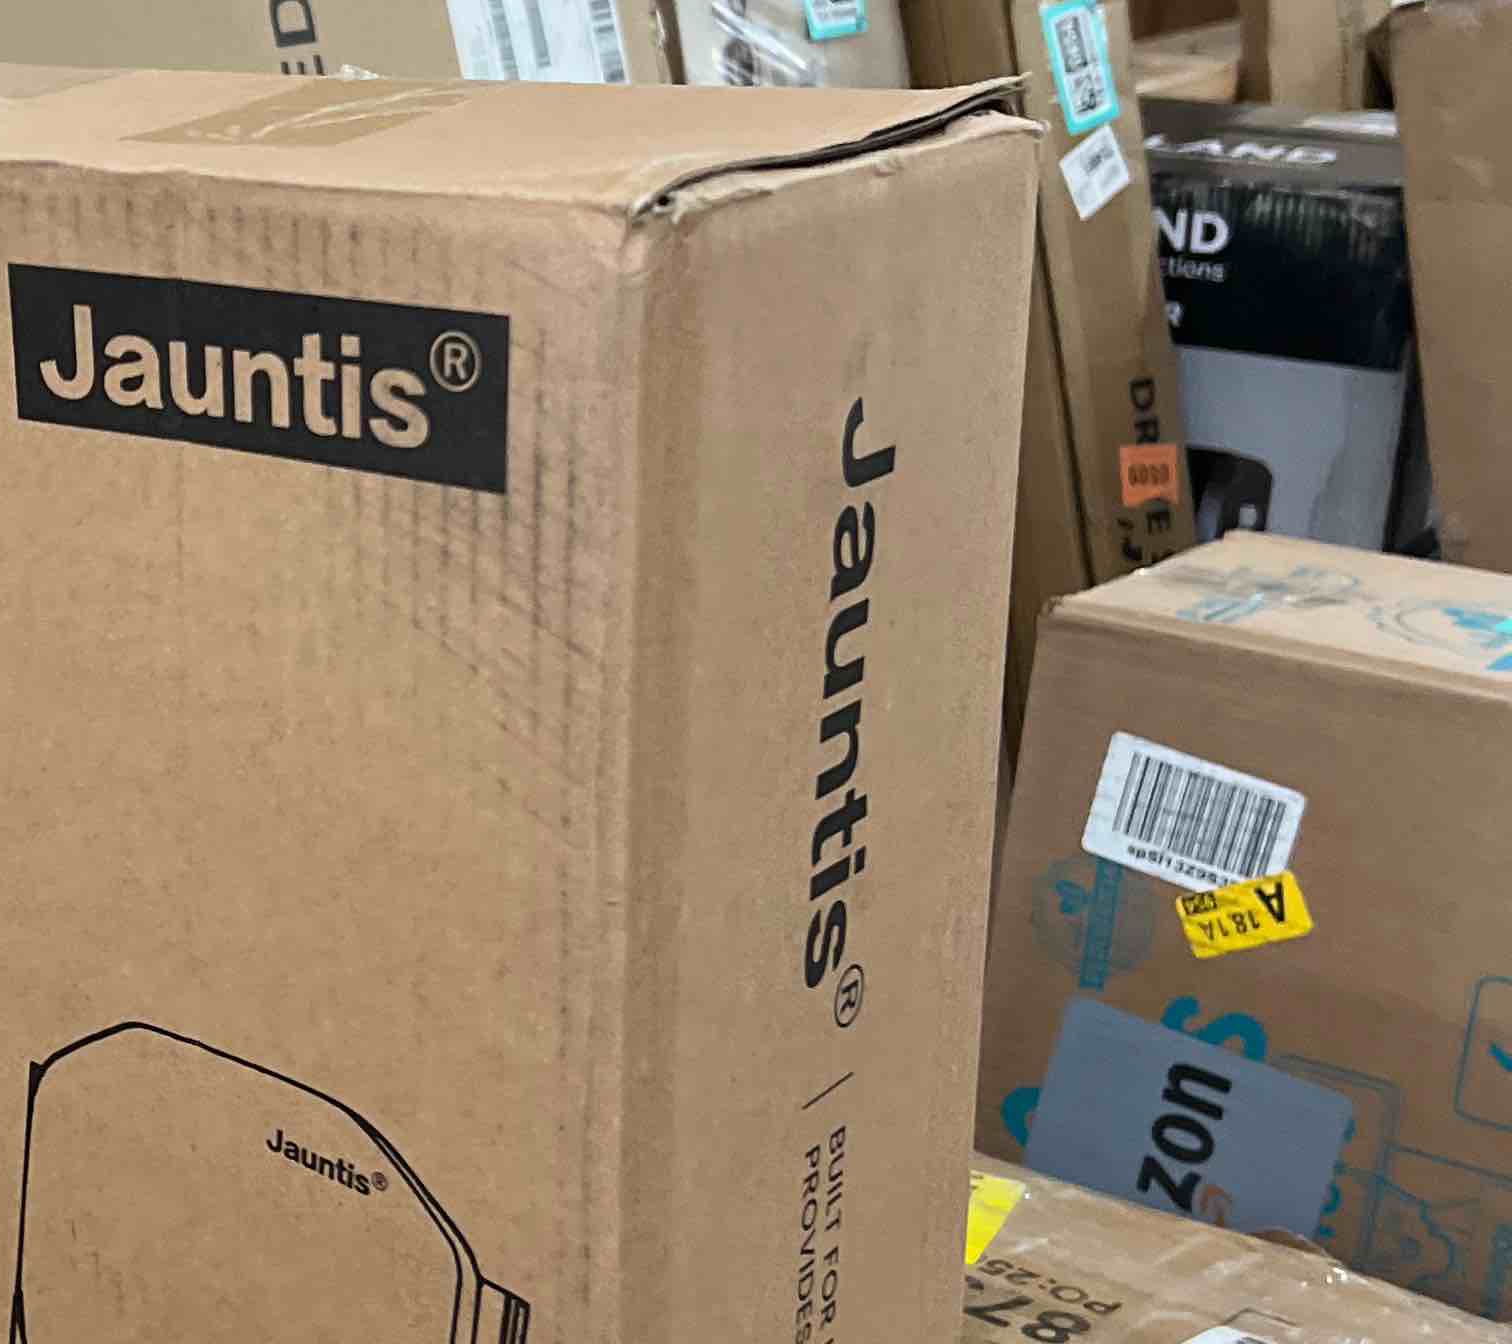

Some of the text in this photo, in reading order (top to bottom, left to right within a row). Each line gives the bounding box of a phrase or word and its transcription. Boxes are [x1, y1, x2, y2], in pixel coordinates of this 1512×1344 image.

[1256, 880, 1287, 925] A
[824, 1124, 847, 1232] BUILT
[820, 1246, 841, 1339] FOR
